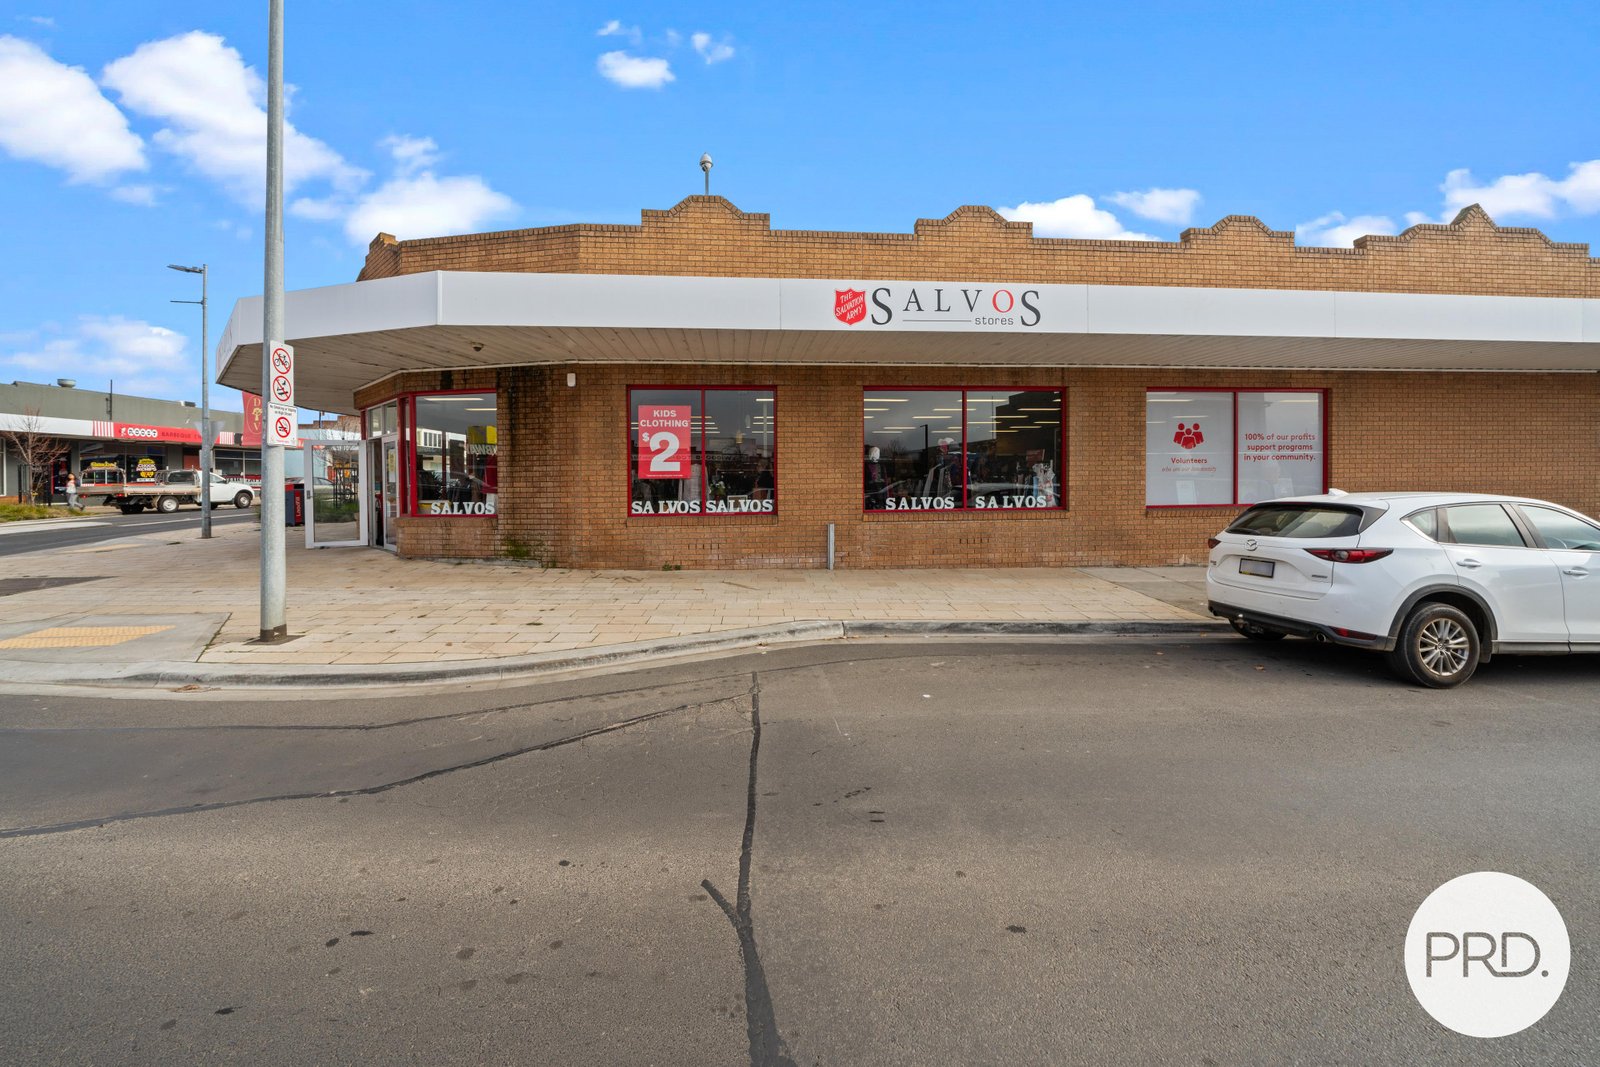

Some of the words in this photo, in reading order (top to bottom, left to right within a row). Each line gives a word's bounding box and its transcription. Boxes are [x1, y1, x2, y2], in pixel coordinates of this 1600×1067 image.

[840, 292, 853, 304] THE
[835, 294, 864, 317] SALVATION
[871, 287, 1041, 327] SALVOS
[845, 305, 864, 321] ARMY
[974, 316, 1014, 326] stores
[653, 409, 677, 418] KIDS
[640, 419, 688, 428] CLOTHING
[1244, 433, 1265, 441] 100%
[1266, 433, 1275, 441] of
[1290, 433, 1316, 442] profits
[1247, 444, 1276, 452] support
[1278, 444, 1313, 452] programs
[1244, 453, 1252, 461] in
[1252, 454, 1270, 462] your
[1271, 453, 1316, 462] community.
[430, 502, 495, 515] SALVOS
[706, 499, 774, 513] SALVOS
[886, 496, 955, 510] SALVOS
